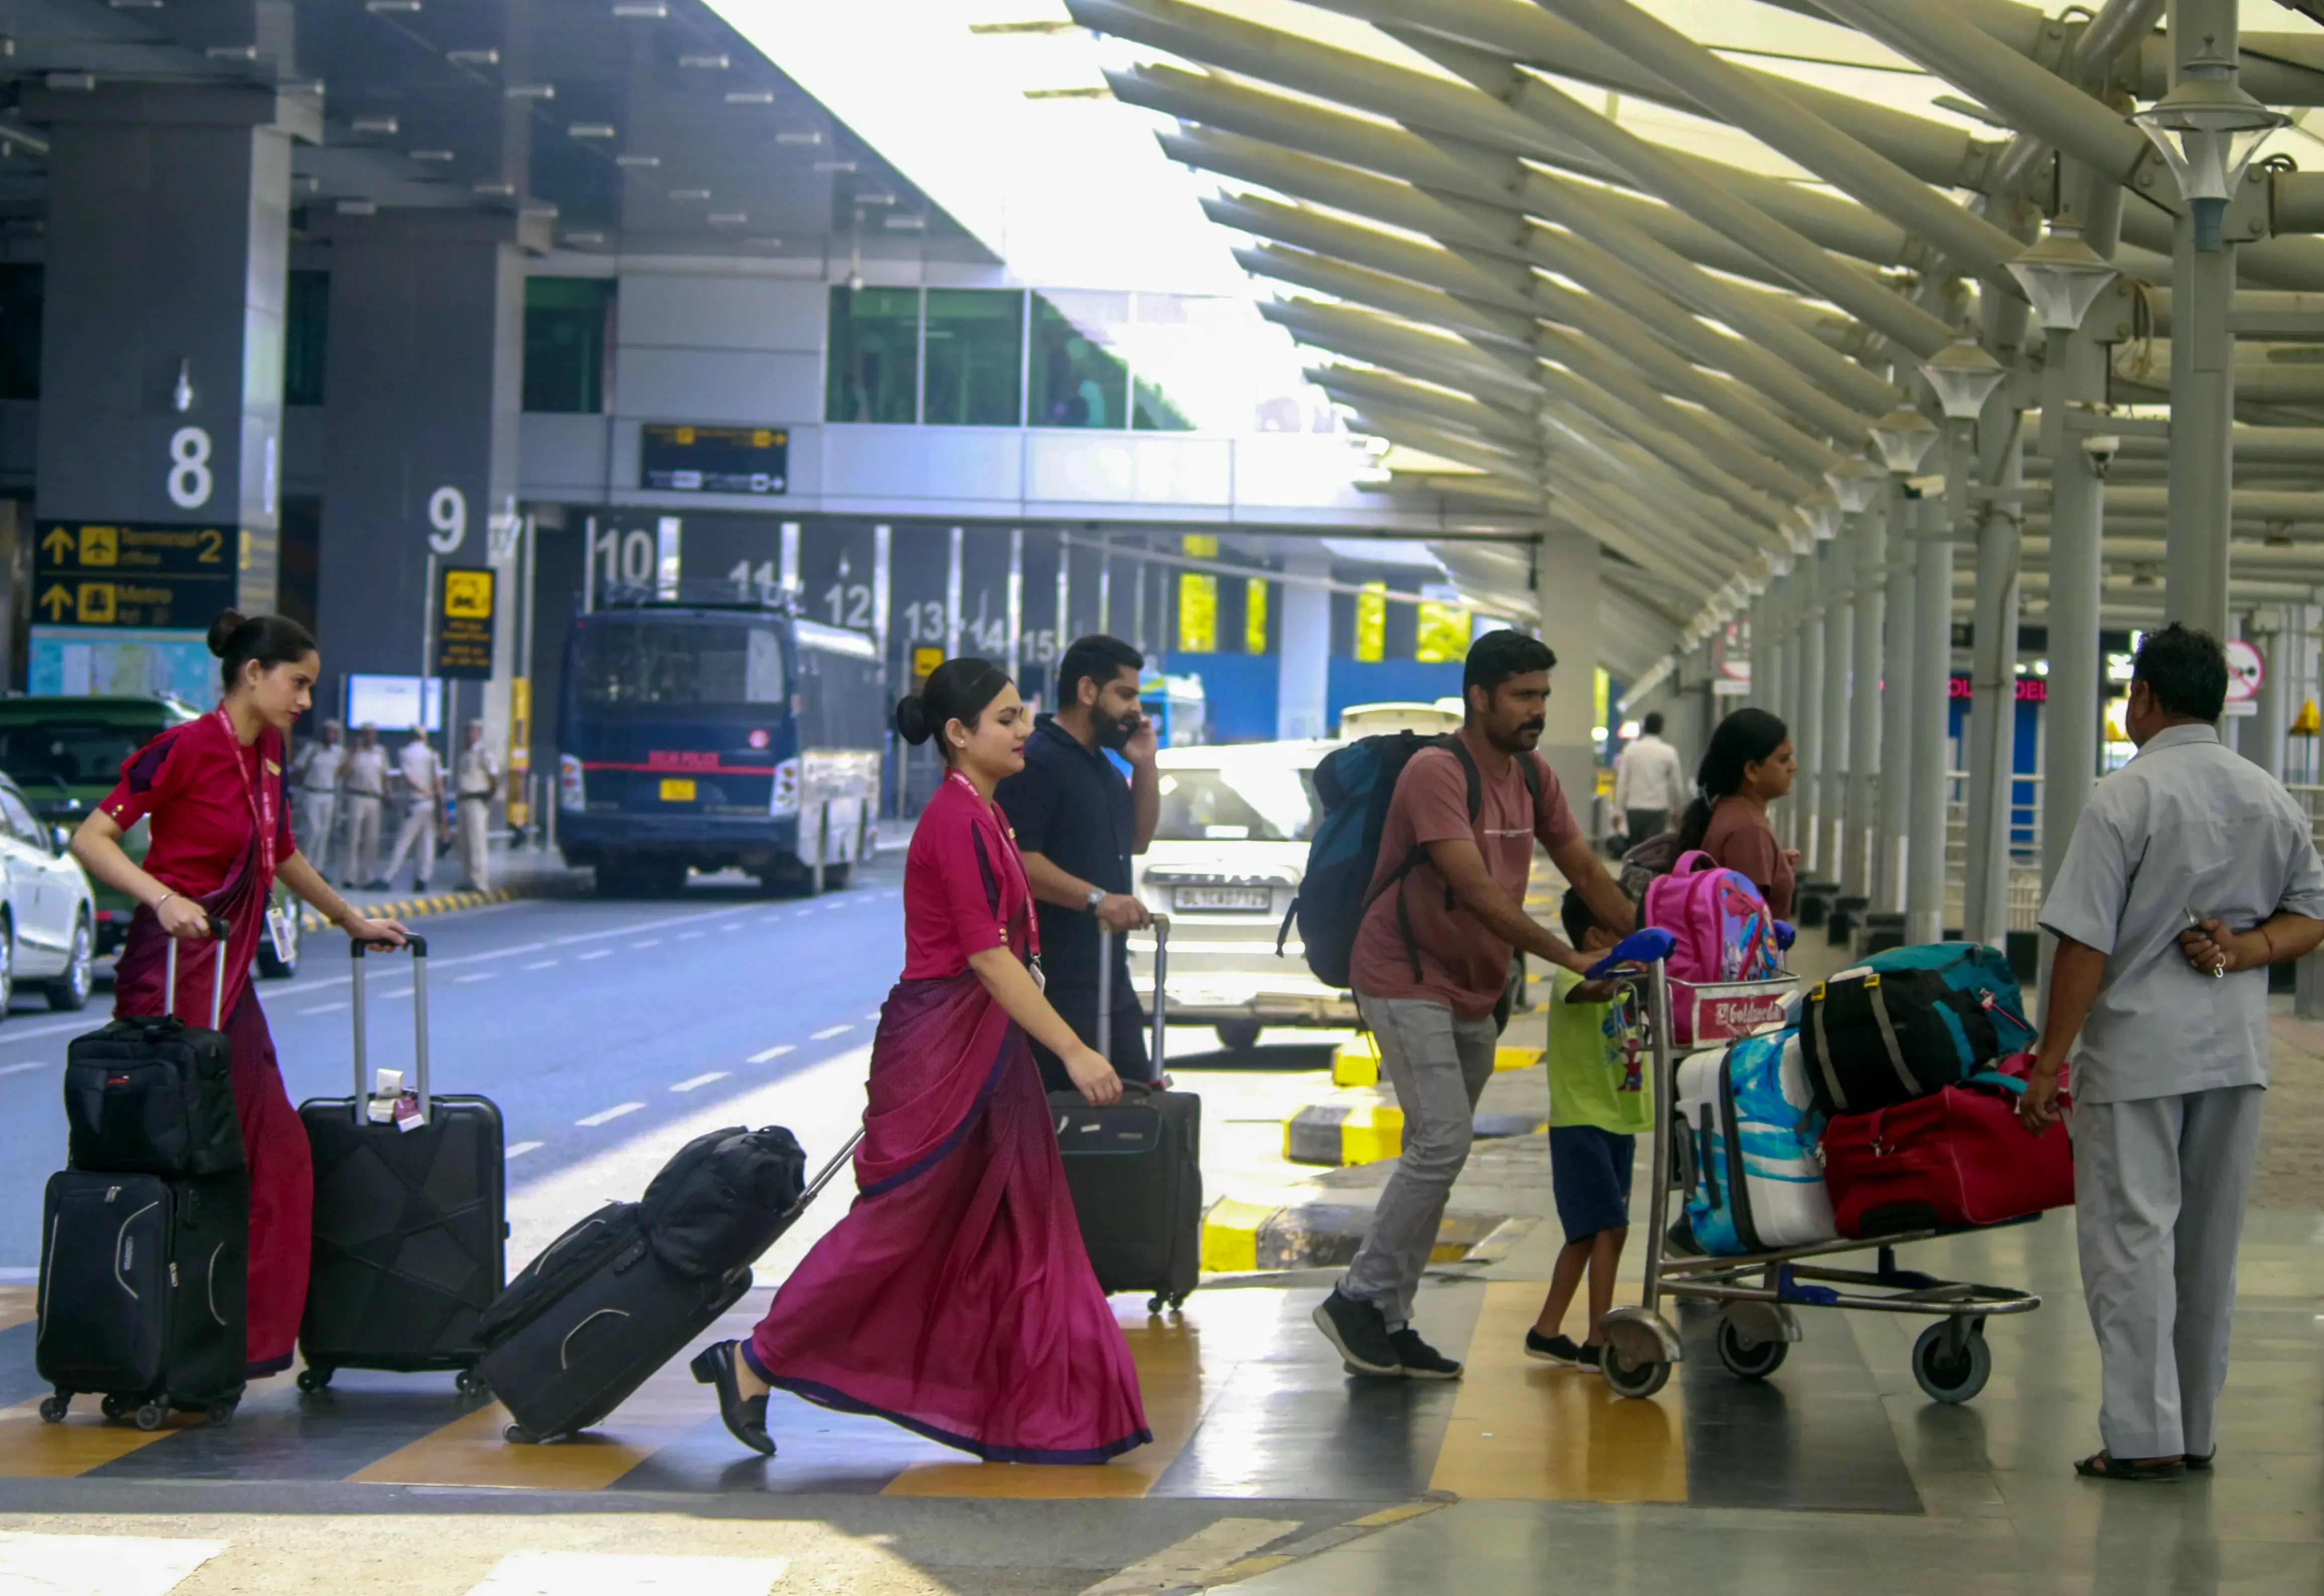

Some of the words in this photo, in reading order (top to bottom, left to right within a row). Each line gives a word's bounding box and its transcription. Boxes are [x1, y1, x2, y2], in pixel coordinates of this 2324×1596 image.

[167, 426, 214, 509] 8
[428, 484, 466, 555] 9
[197, 529, 223, 562] 2
[596, 528, 654, 589] 10
[728, 559, 776, 603] 11
[824, 583, 872, 628] 12
[905, 601, 944, 641] 13
[969, 618, 1005, 653] 14
[1023, 630, 1054, 663] 15
